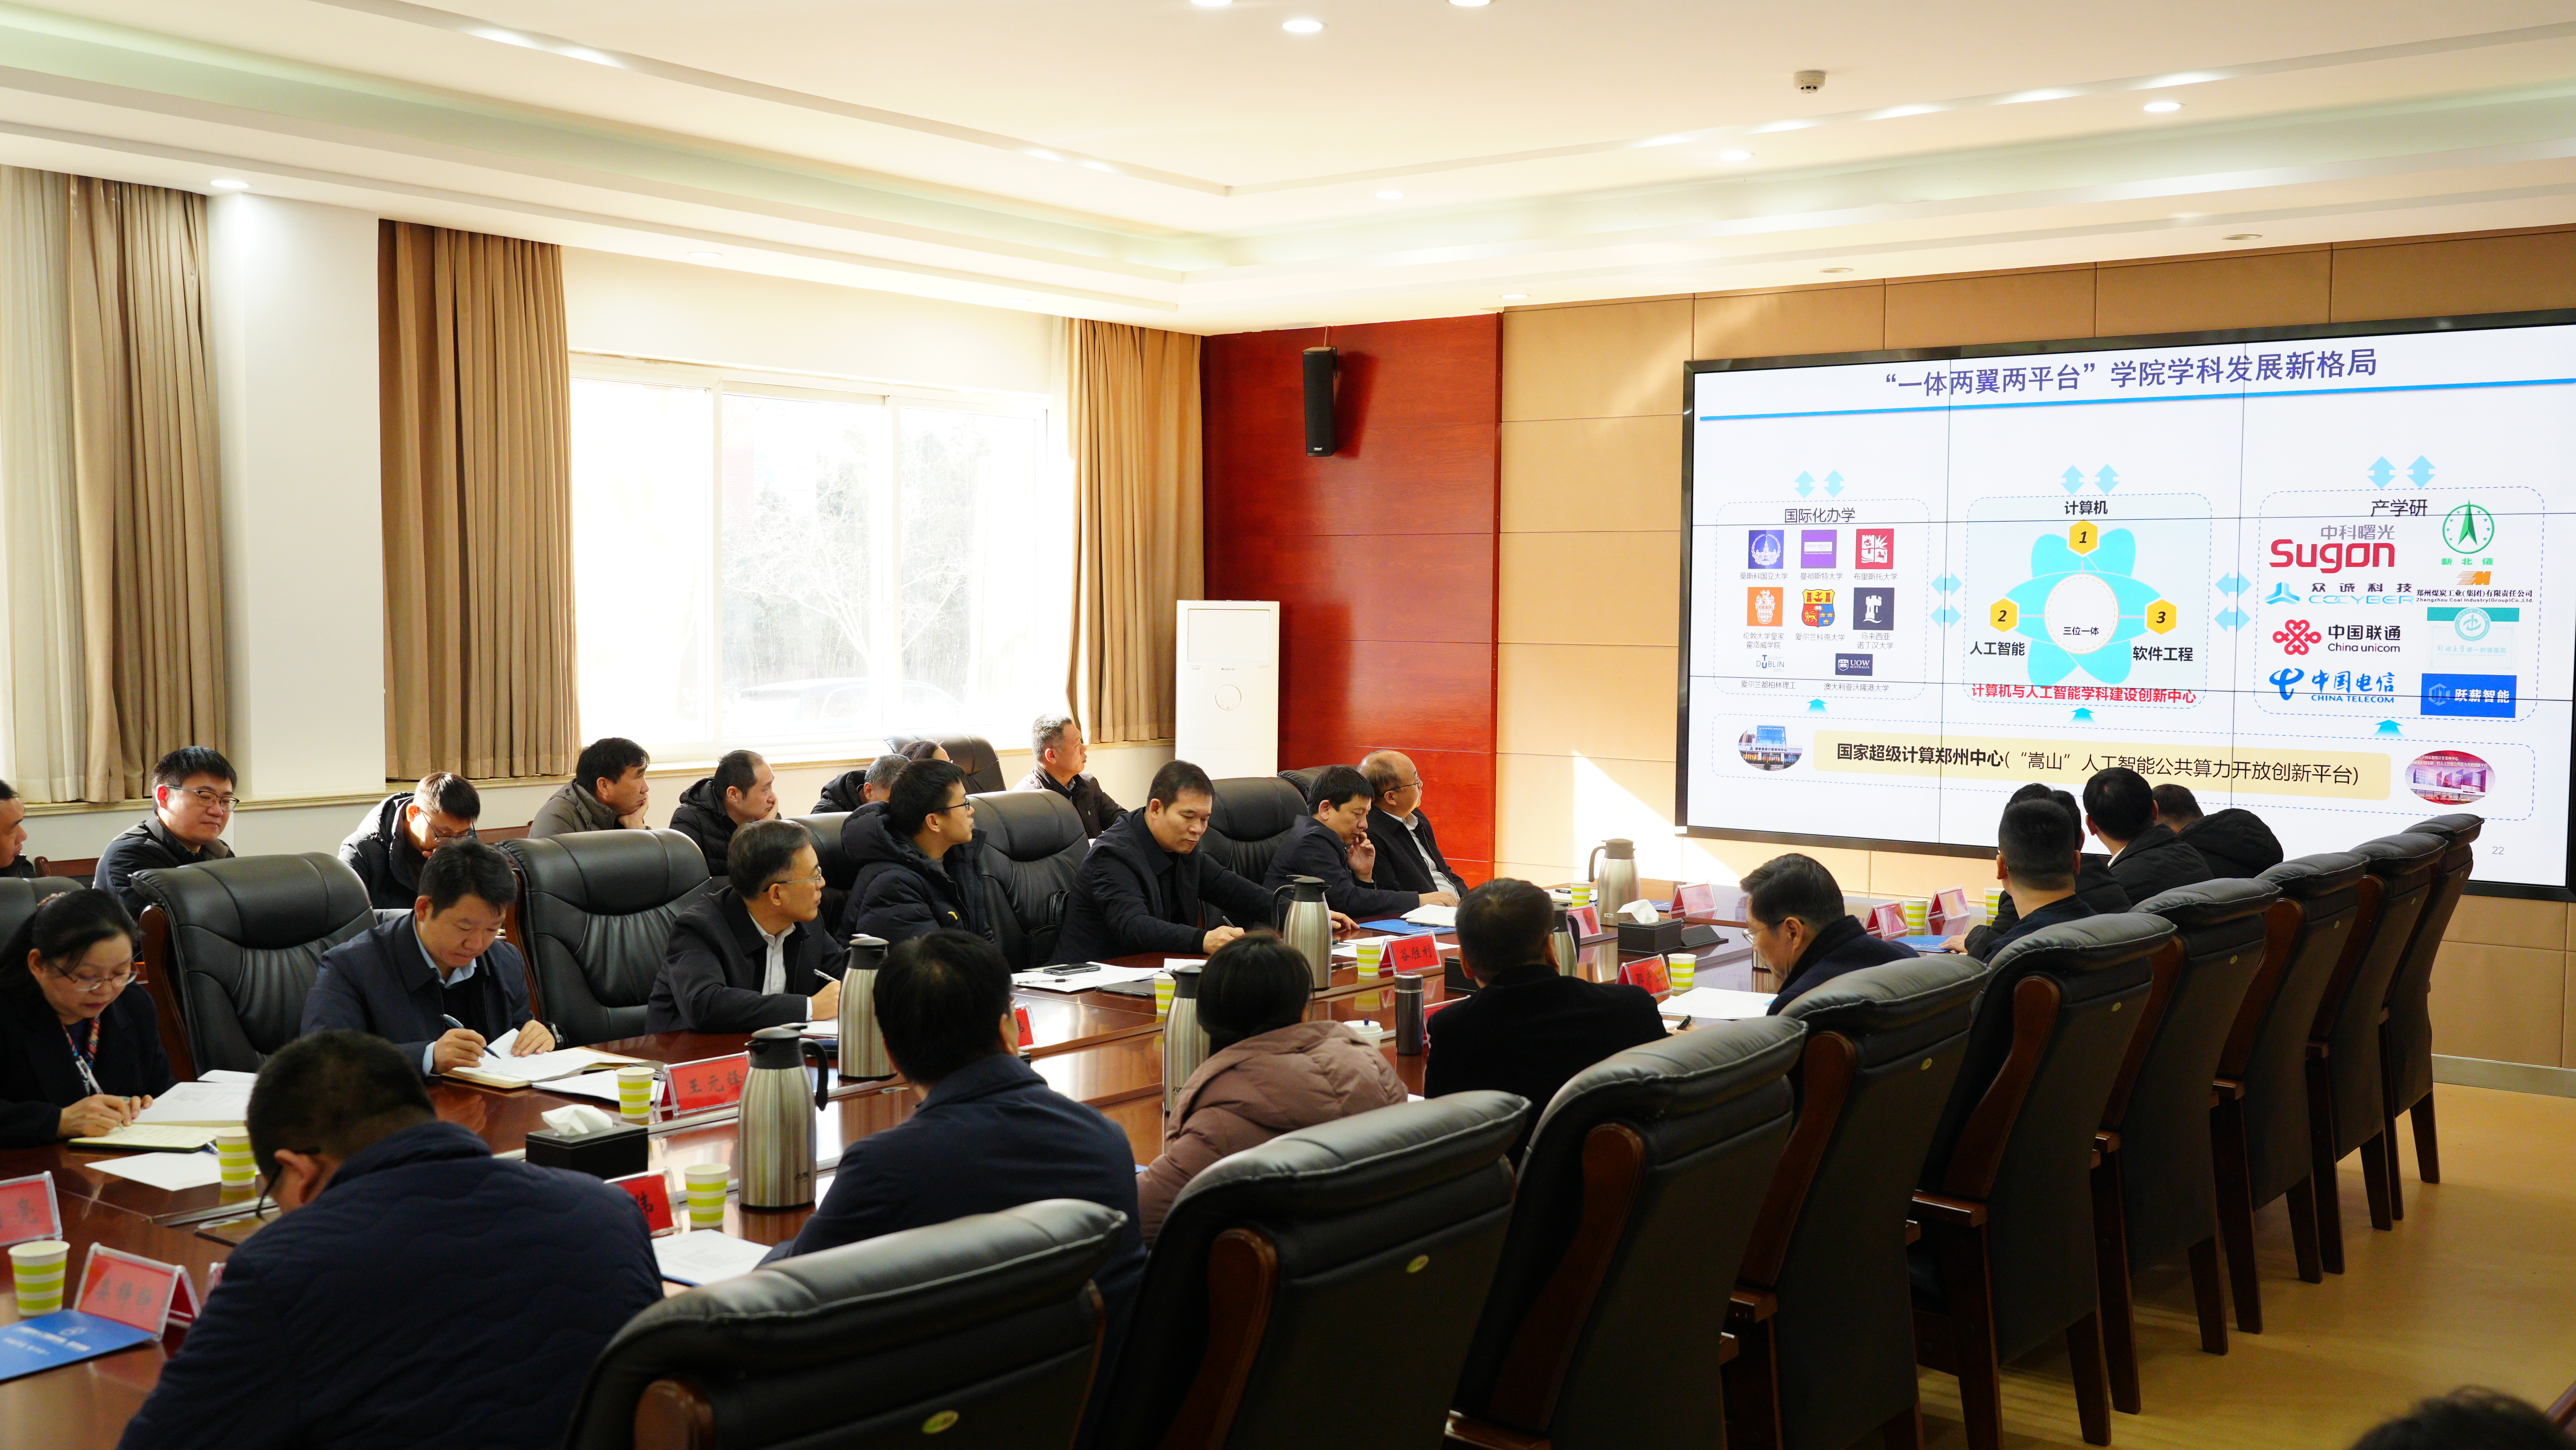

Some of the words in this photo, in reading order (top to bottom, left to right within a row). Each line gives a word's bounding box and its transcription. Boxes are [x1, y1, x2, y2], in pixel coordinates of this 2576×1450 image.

[1886, 349, 2376, 397] “一体两翼两平台”学院学科发展新格局
[2065, 500, 2108, 515] 计算机
[2371, 499, 2428, 517] 产学研
[1785, 508, 1855, 523] 国际化办学
[2079, 531, 2087, 543] 1
[2321, 525, 2395, 540] 中科曙光
[2269, 539, 2395, 573] Sugon
[1740, 572, 1788, 581] 莫斯科国立大学
[1854, 573, 1897, 581] 布里斯托大学
[2311, 583, 2412, 592] 众诚科技
[1998, 610, 2007, 622] 2
[2157, 611, 2166, 624] 3
[2063, 626, 2099, 636] 三位一体
[2328, 625, 2401, 640] 中国联通
[1969, 641, 2025, 656] 人工智能
[2133, 646, 2193, 661] 软件工程
[2328, 643, 2358, 652] China
[2361, 644, 2400, 652] unicom
[1741, 681, 1796, 689] 爱尔兰都柏林理工
[2312, 669, 2395, 693] 中国电信
[1971, 683, 2196, 704] 计算机与人工智能学科建设创新中心
[2454, 689, 2510, 703] 跃薪智能
[2492, 846, 2504, 855] 22
[1400, 944, 1432, 961] 谷胜利
